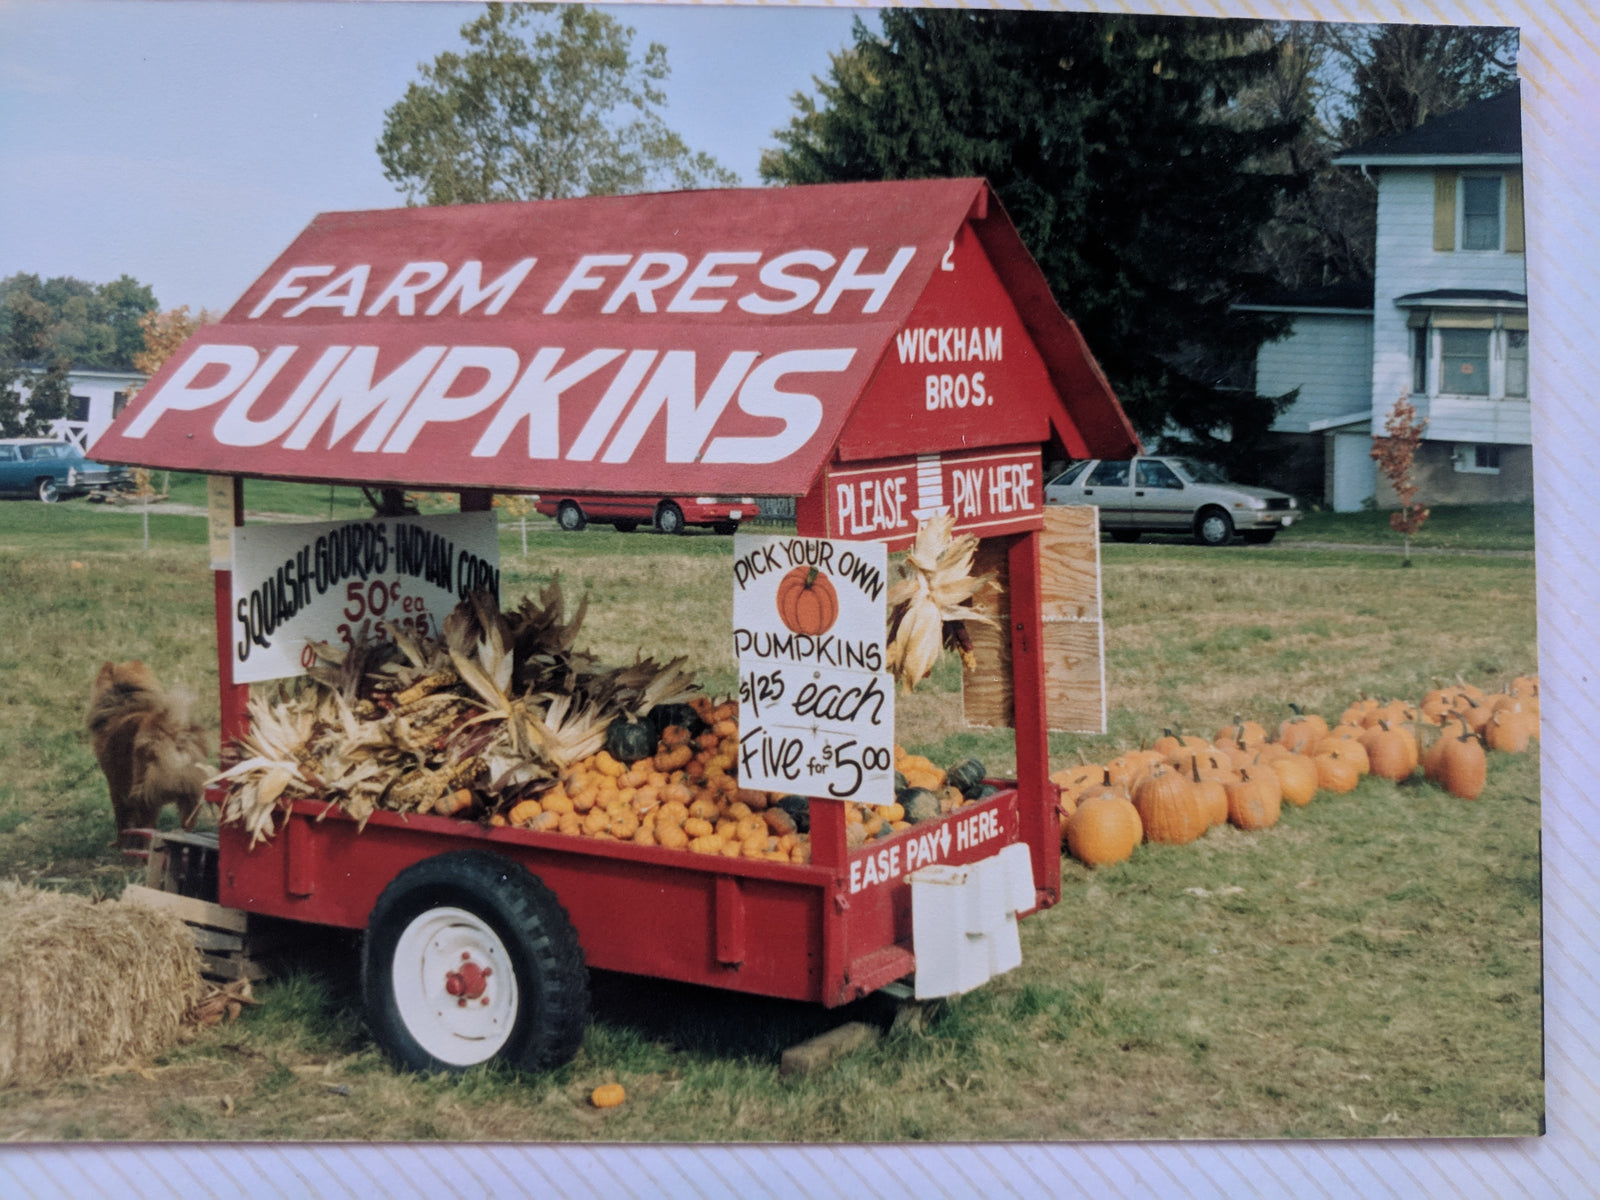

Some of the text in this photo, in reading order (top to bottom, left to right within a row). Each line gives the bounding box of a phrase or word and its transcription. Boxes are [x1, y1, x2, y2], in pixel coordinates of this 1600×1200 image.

[247, 245, 917, 319] FARM FRESH
[896, 326, 1002, 364] WICKHAM
[121, 341, 858, 466] PUMPKINS
[925, 371, 994, 411] BROS.
[836, 462, 1035, 537] PLEASE PAY HERE
[733, 538, 884, 602] PICK YOUR OWN
[733, 629, 882, 672] PUMPKINS
[791, 677, 885, 726] each
[740, 726, 803, 781] Five
[806, 755, 829, 777] for
[849, 808, 1004, 894] EASE PAY HERE.
